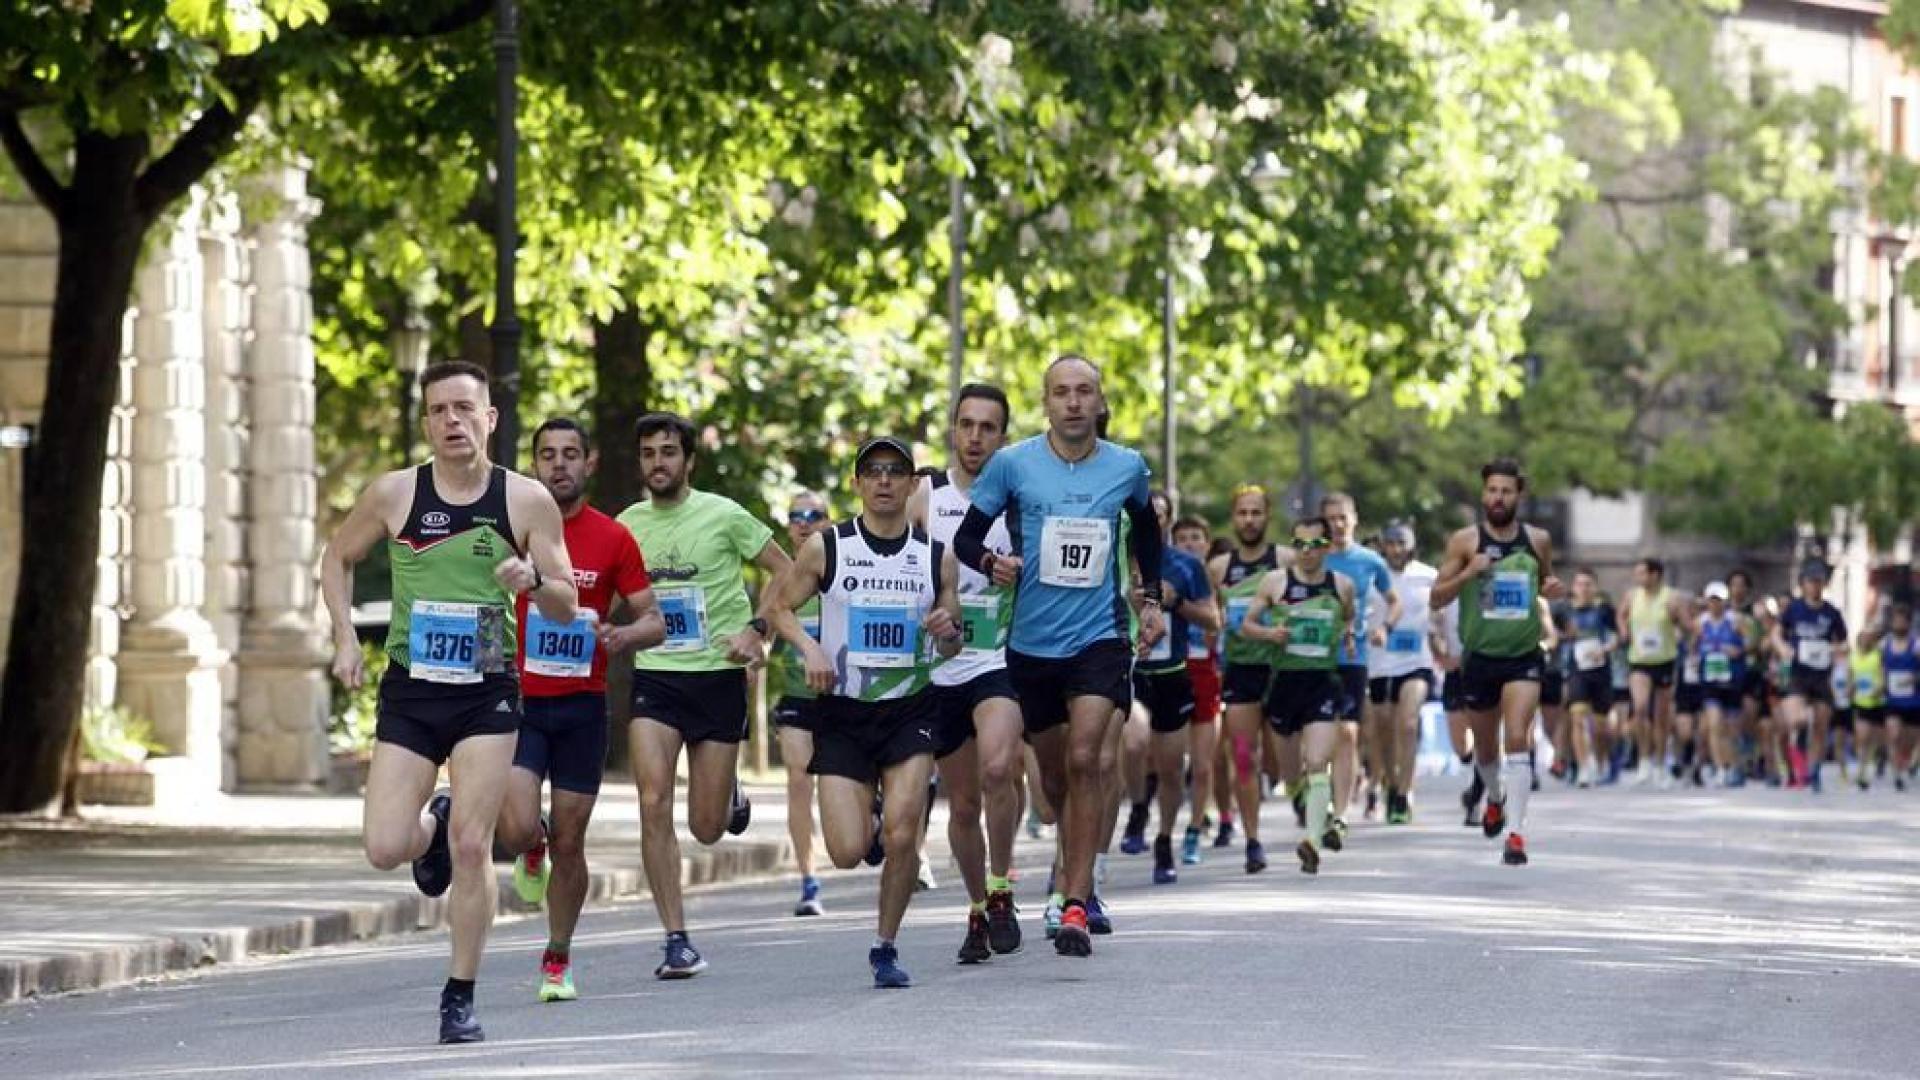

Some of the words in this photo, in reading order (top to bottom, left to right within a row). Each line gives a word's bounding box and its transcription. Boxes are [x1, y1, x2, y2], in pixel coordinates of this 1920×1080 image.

[424, 513, 447, 525] KIA
[1061, 544, 1092, 568] 197
[862, 578, 925, 593] etzenike
[425, 632, 474, 662] 1376
[538, 631, 584, 658] 1340
[863, 622, 904, 649] 1180
